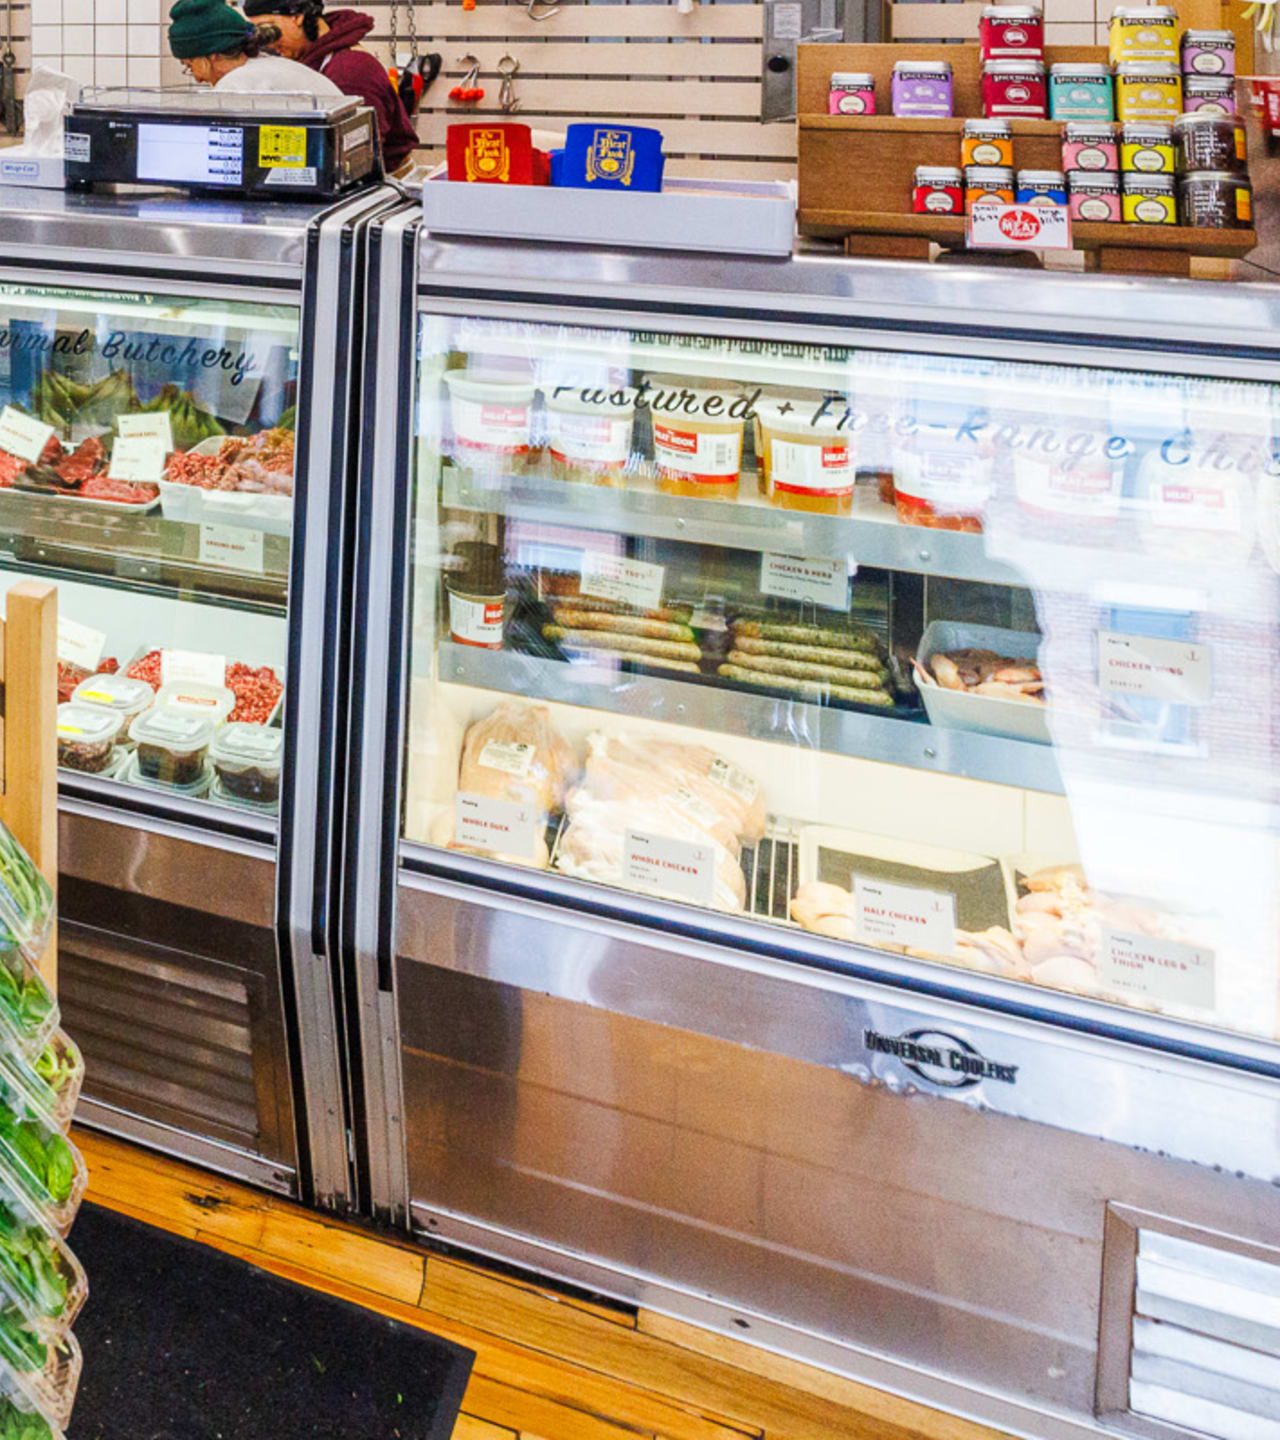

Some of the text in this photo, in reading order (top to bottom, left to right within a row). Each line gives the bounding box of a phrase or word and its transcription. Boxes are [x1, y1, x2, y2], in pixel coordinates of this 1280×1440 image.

[101, 330, 258, 386] Butchery
[551, 378, 762, 422] Pastured
[809, 394, 1136, 471] Free-Range
[769, 560, 803, 574] CHICKEN
[1108, 659, 1152, 671] CHICKEN
[462, 816, 489, 829] WHOLE
[631, 853, 699, 876] WHOLE CHICKEN
[863, 905, 928, 926] HALF CHICKEN
[1111, 947, 1156, 964] CHICKEN
[1157, 957, 1178, 970] LEG
[1112, 957, 1145, 971] THIGH
[864, 1028, 1020, 1084] UNIVERSAL COOLERS
